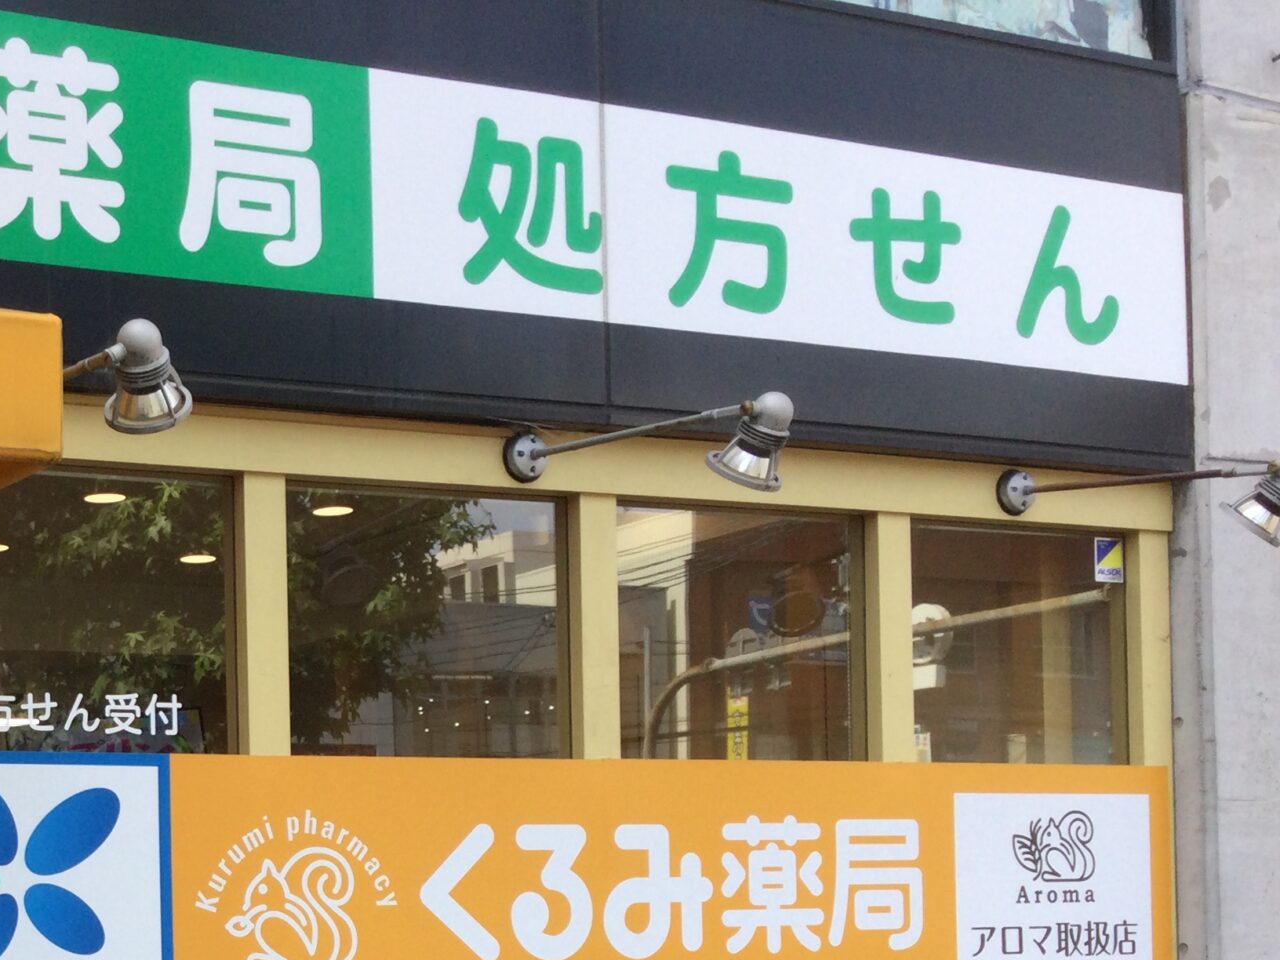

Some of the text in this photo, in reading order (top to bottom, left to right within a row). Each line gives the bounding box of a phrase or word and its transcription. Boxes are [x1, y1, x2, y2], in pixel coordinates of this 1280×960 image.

[457, 115, 1120, 346] 処方せん
[195, 808, 398, 913] Kurumi pharmacy
[1015, 885, 1096, 905] Aroma
[970, 919, 1139, 958] アロマ取扱店
